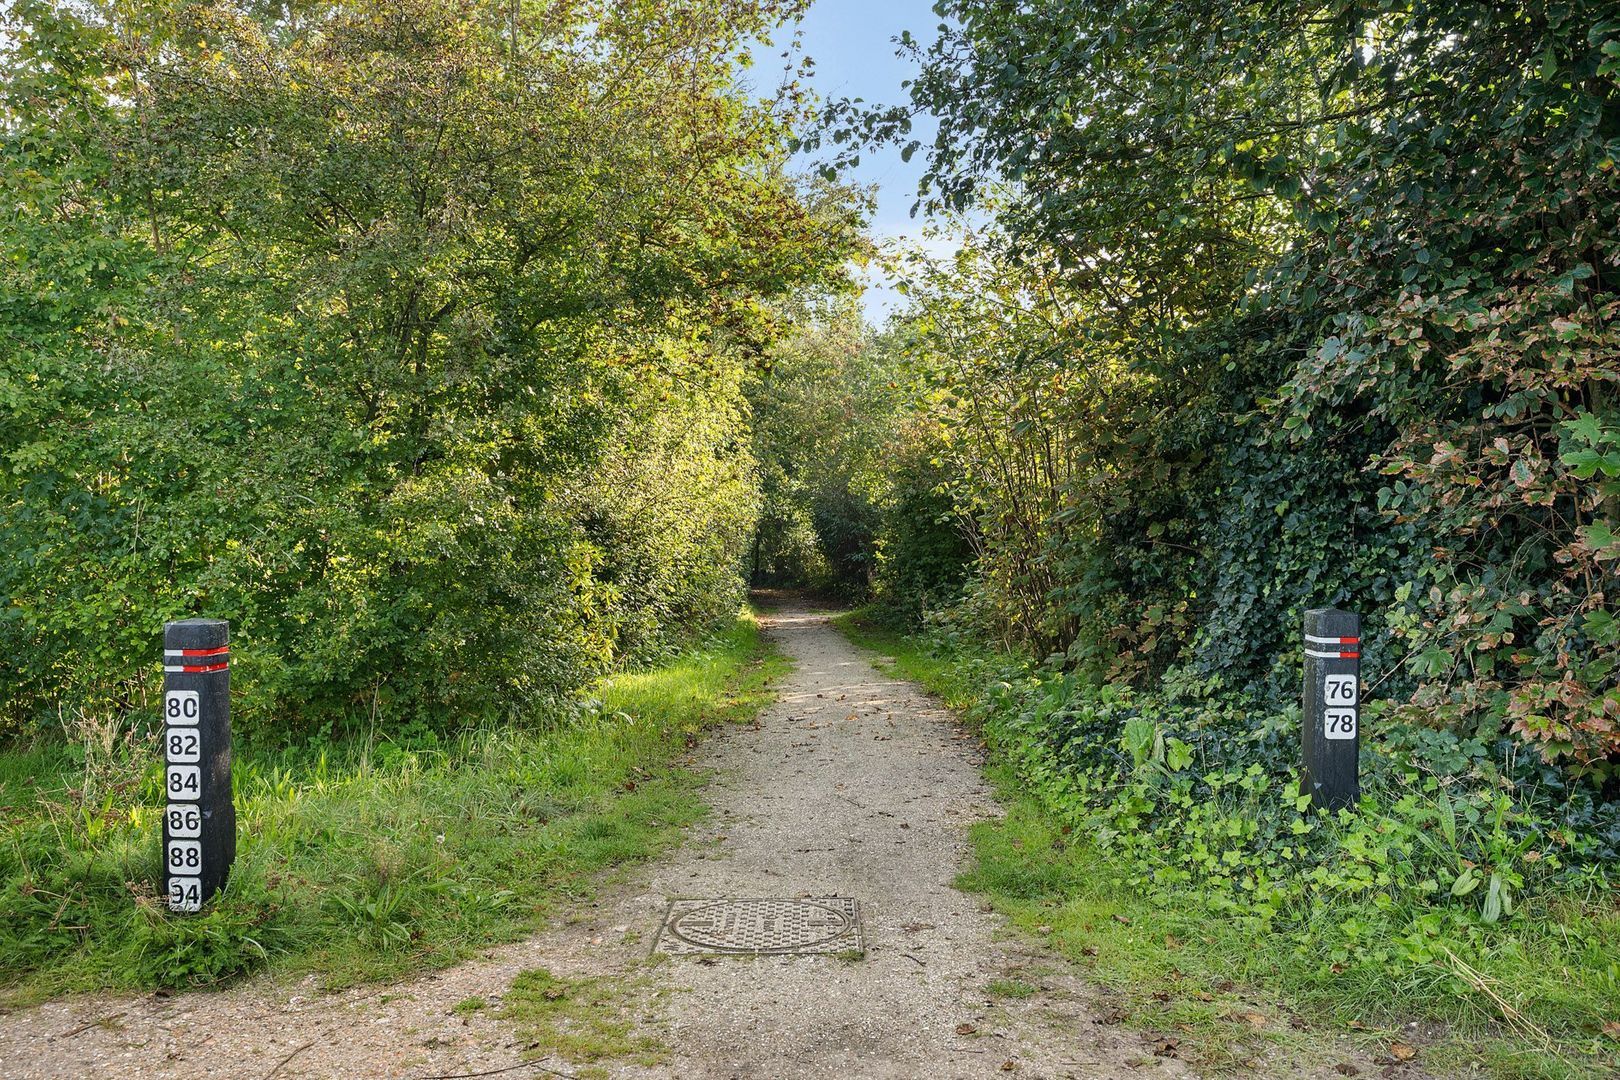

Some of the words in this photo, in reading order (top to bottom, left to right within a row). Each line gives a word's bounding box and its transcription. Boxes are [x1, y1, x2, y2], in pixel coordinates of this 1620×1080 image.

[1328, 681, 1354, 699] 76
[167, 697, 197, 718] 80
[1327, 714, 1353, 733] 78
[169, 735, 198, 756] 82
[169, 772, 199, 793] 84
[169, 810, 199, 831] 86
[170, 847, 200, 868] 88
[171, 884, 200, 905] 94
